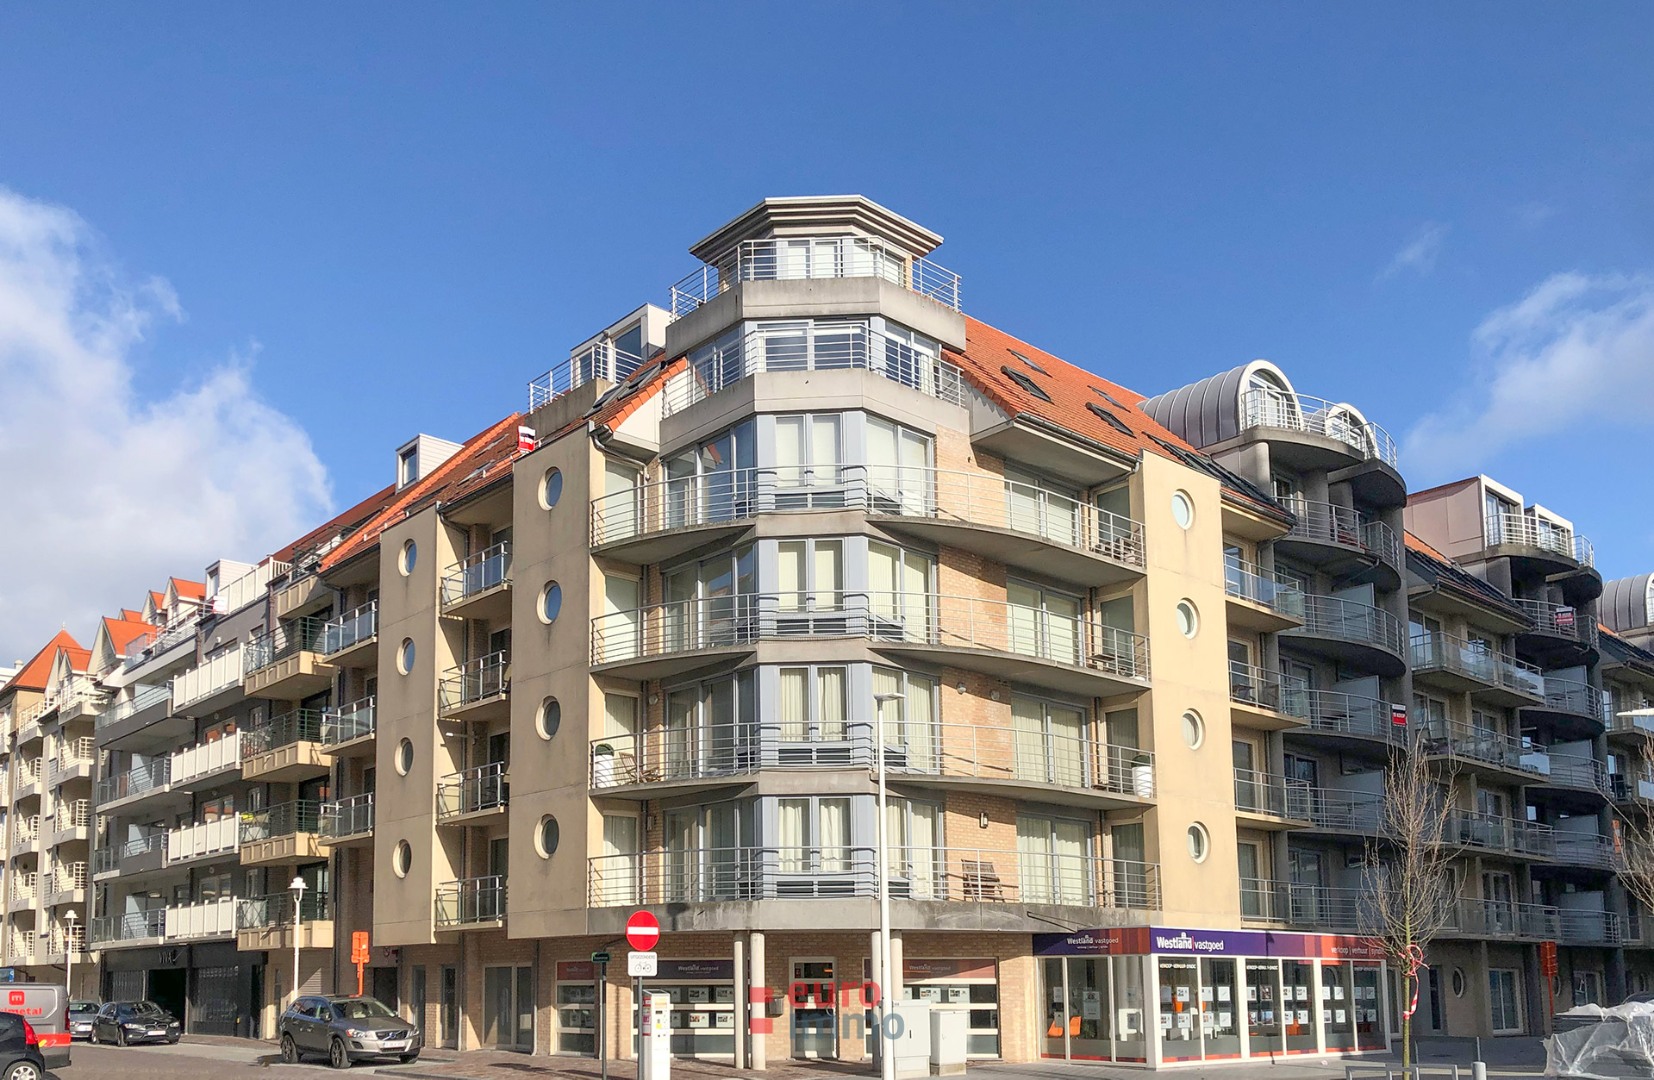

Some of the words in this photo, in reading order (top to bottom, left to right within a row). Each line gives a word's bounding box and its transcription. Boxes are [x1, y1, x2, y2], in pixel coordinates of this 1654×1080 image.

[1095, 937, 1119, 945] vastgoed
[1156, 933, 1192, 949] Westland
[1194, 940, 1224, 952] vastgoed
